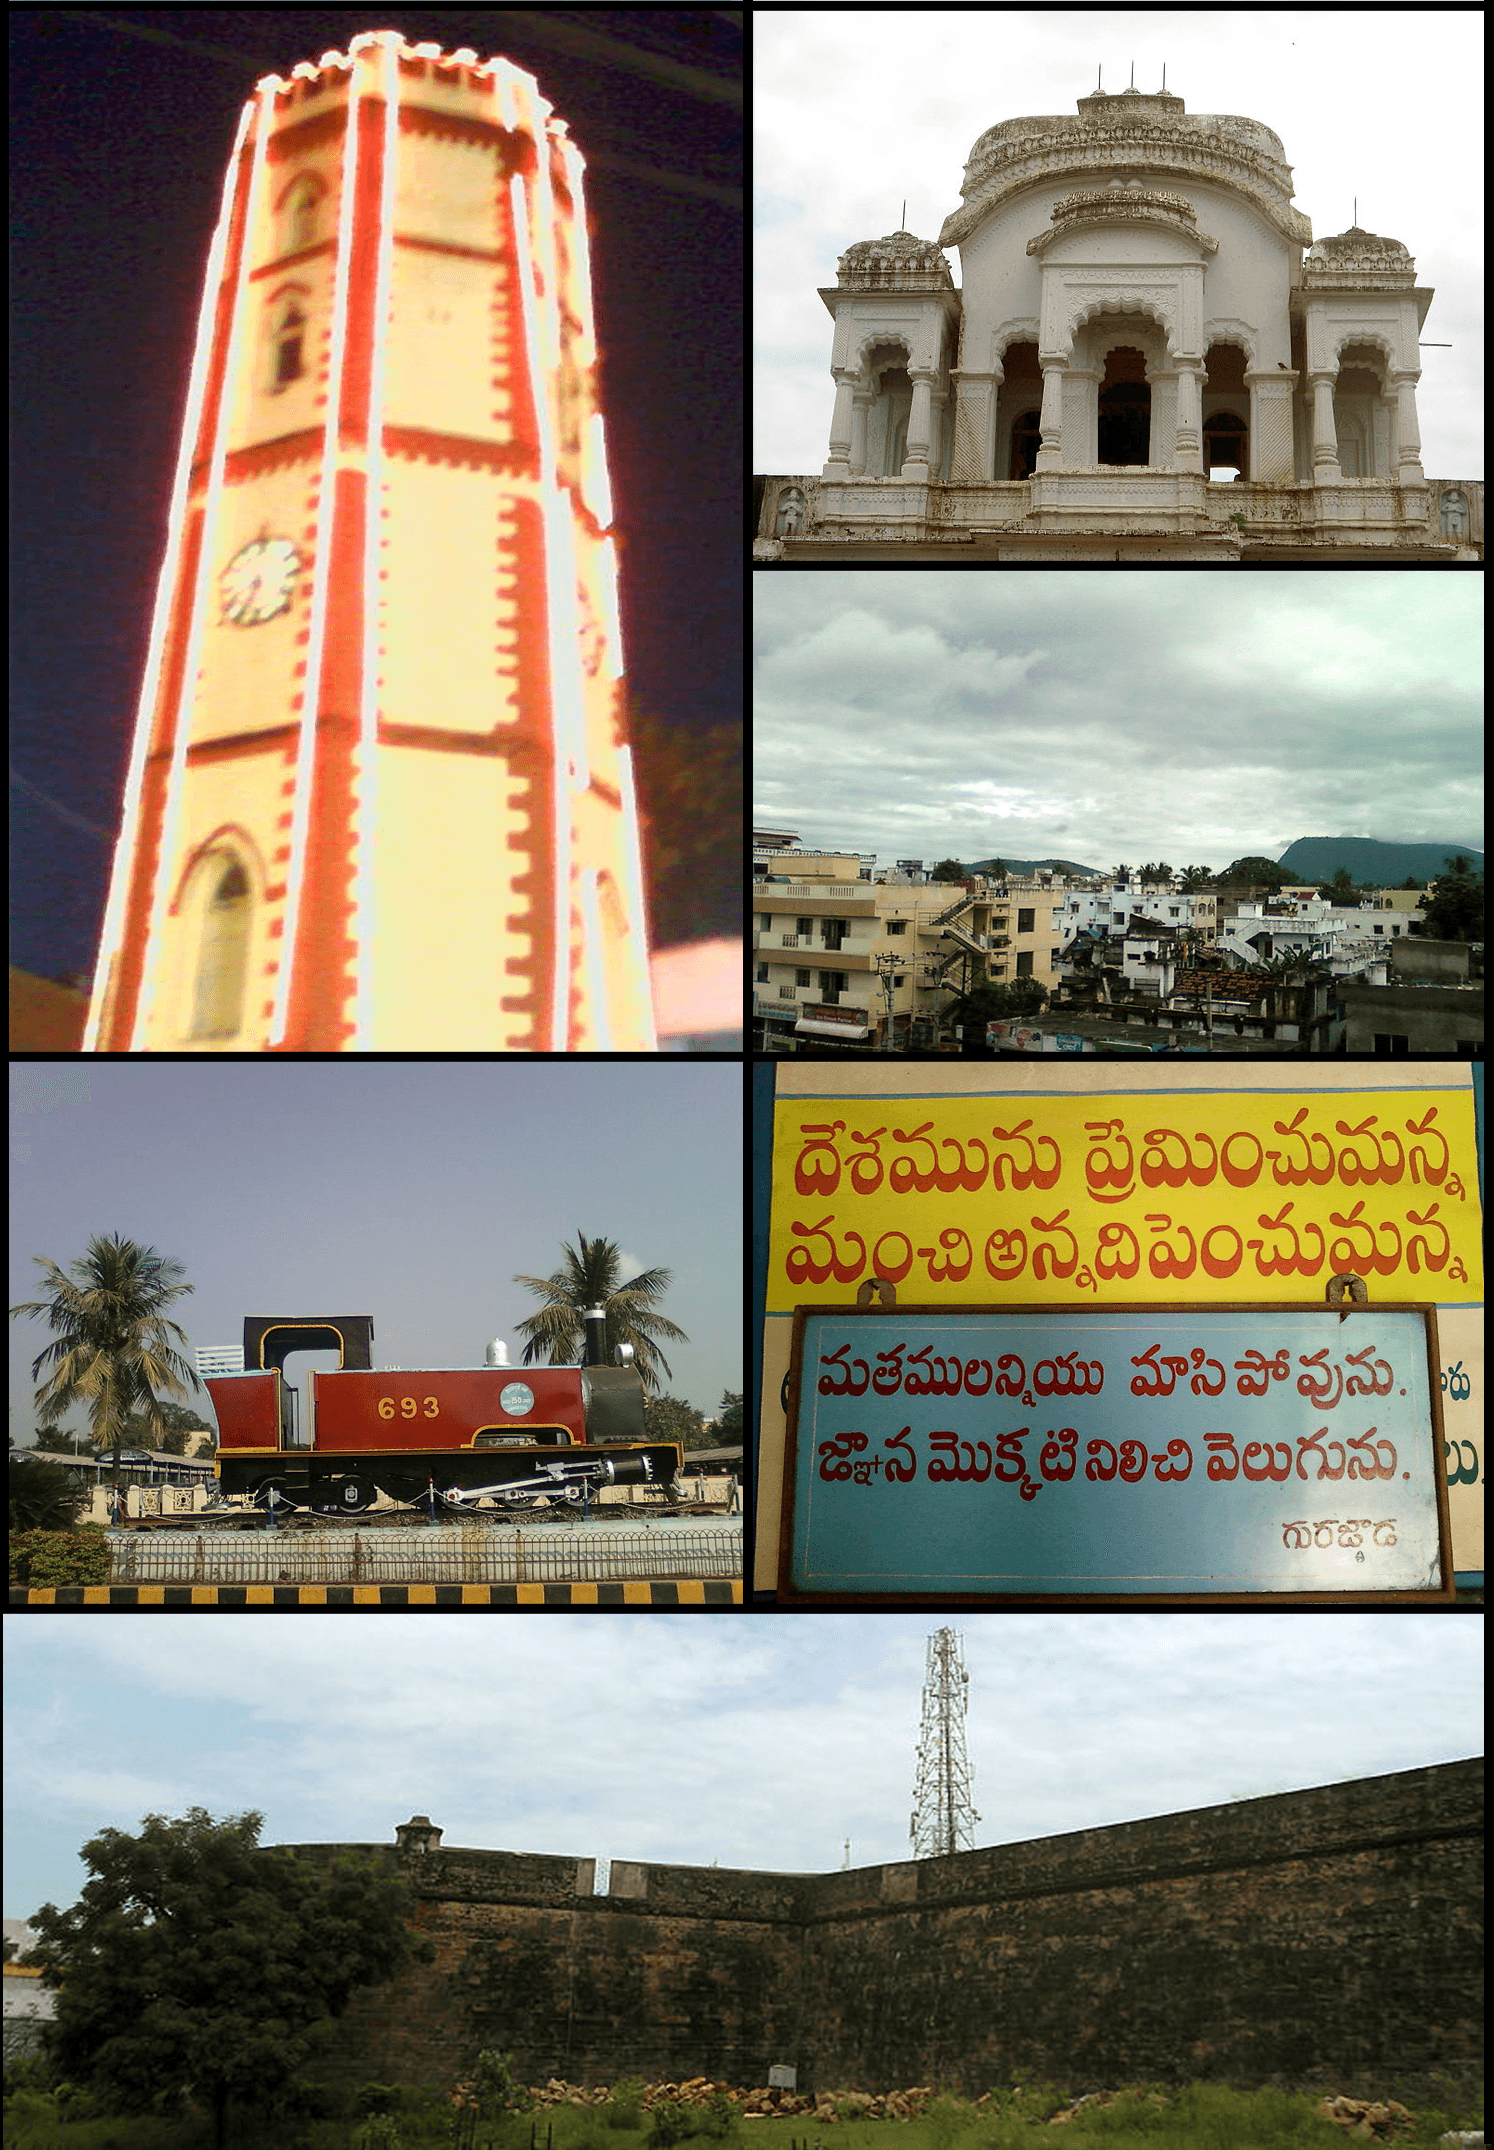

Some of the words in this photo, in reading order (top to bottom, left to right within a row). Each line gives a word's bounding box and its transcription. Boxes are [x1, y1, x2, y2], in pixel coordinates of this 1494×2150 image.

[793, 1119, 1062, 1196] దేశమును
[1084, 1107, 1466, 1204] ప్రేమించుమన్న
[785, 1214, 973, 1285] మంచి
[378, 1396, 440, 1420] 693
[818, 1344, 1105, 1407] మతములన్నియు
